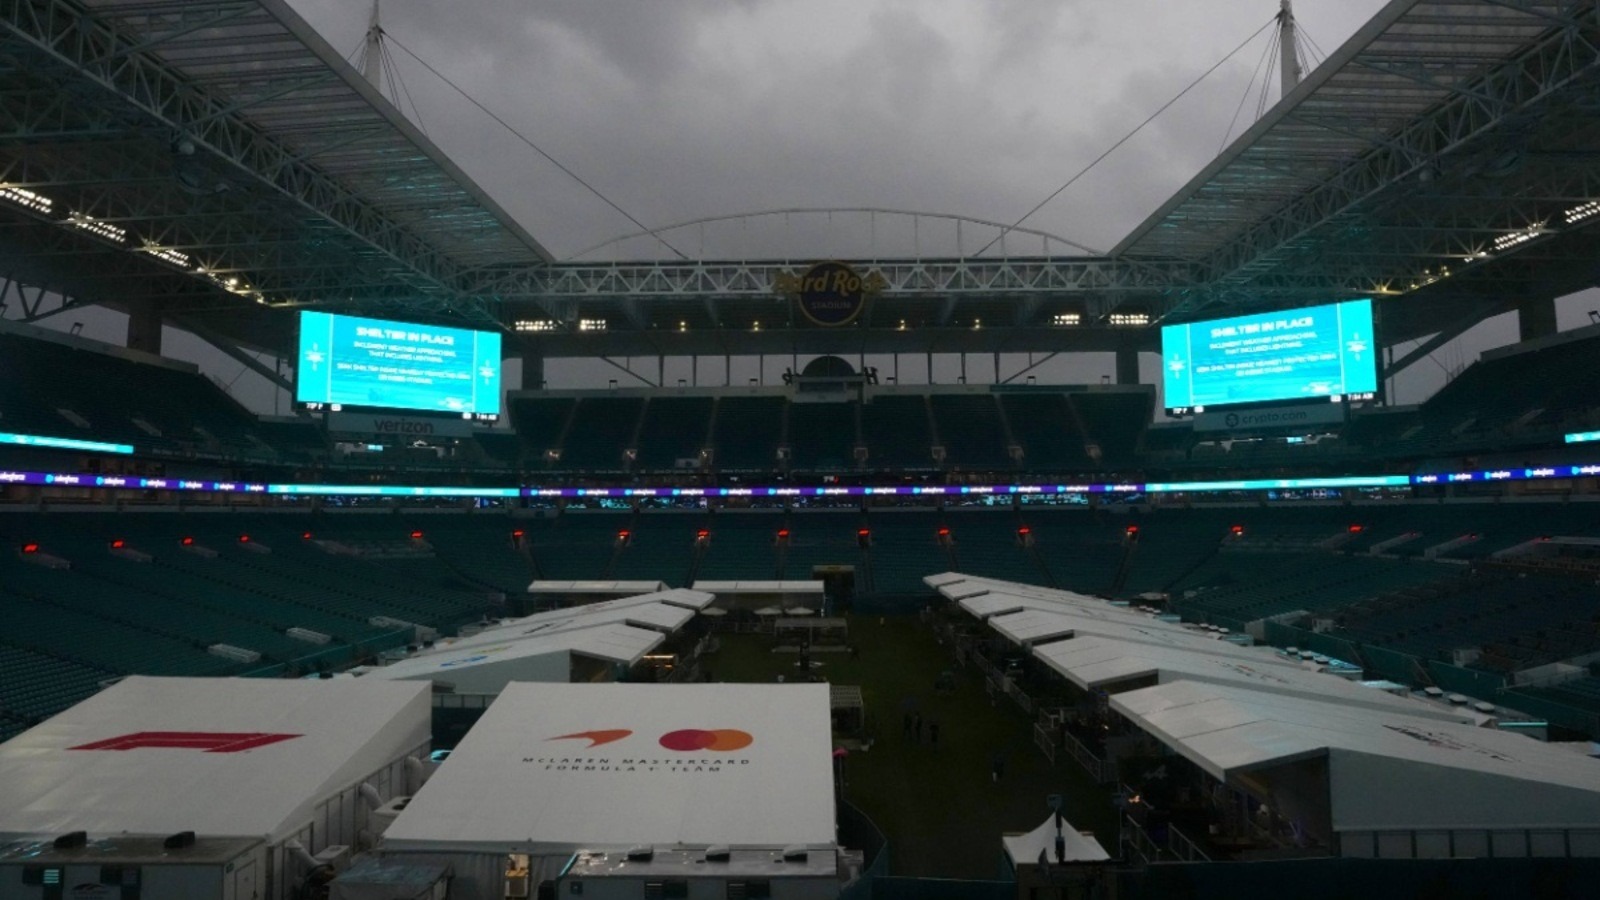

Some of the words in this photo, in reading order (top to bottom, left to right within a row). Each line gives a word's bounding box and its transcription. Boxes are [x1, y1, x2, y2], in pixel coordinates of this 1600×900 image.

[811, 301, 852, 310] STADIUM
[1210, 323, 1260, 338] SHELTER
[1261, 320, 1275, 332] IN
[1276, 316, 1314, 328] PLACE
[356, 326, 405, 341] SHELTER
[407, 331, 420, 342] IN
[420, 333, 454, 346] PLACE
[1242, 411, 1307, 425] crypto.com
[374, 418, 434, 433] verizon
[545, 764, 635, 772] FORMULA
